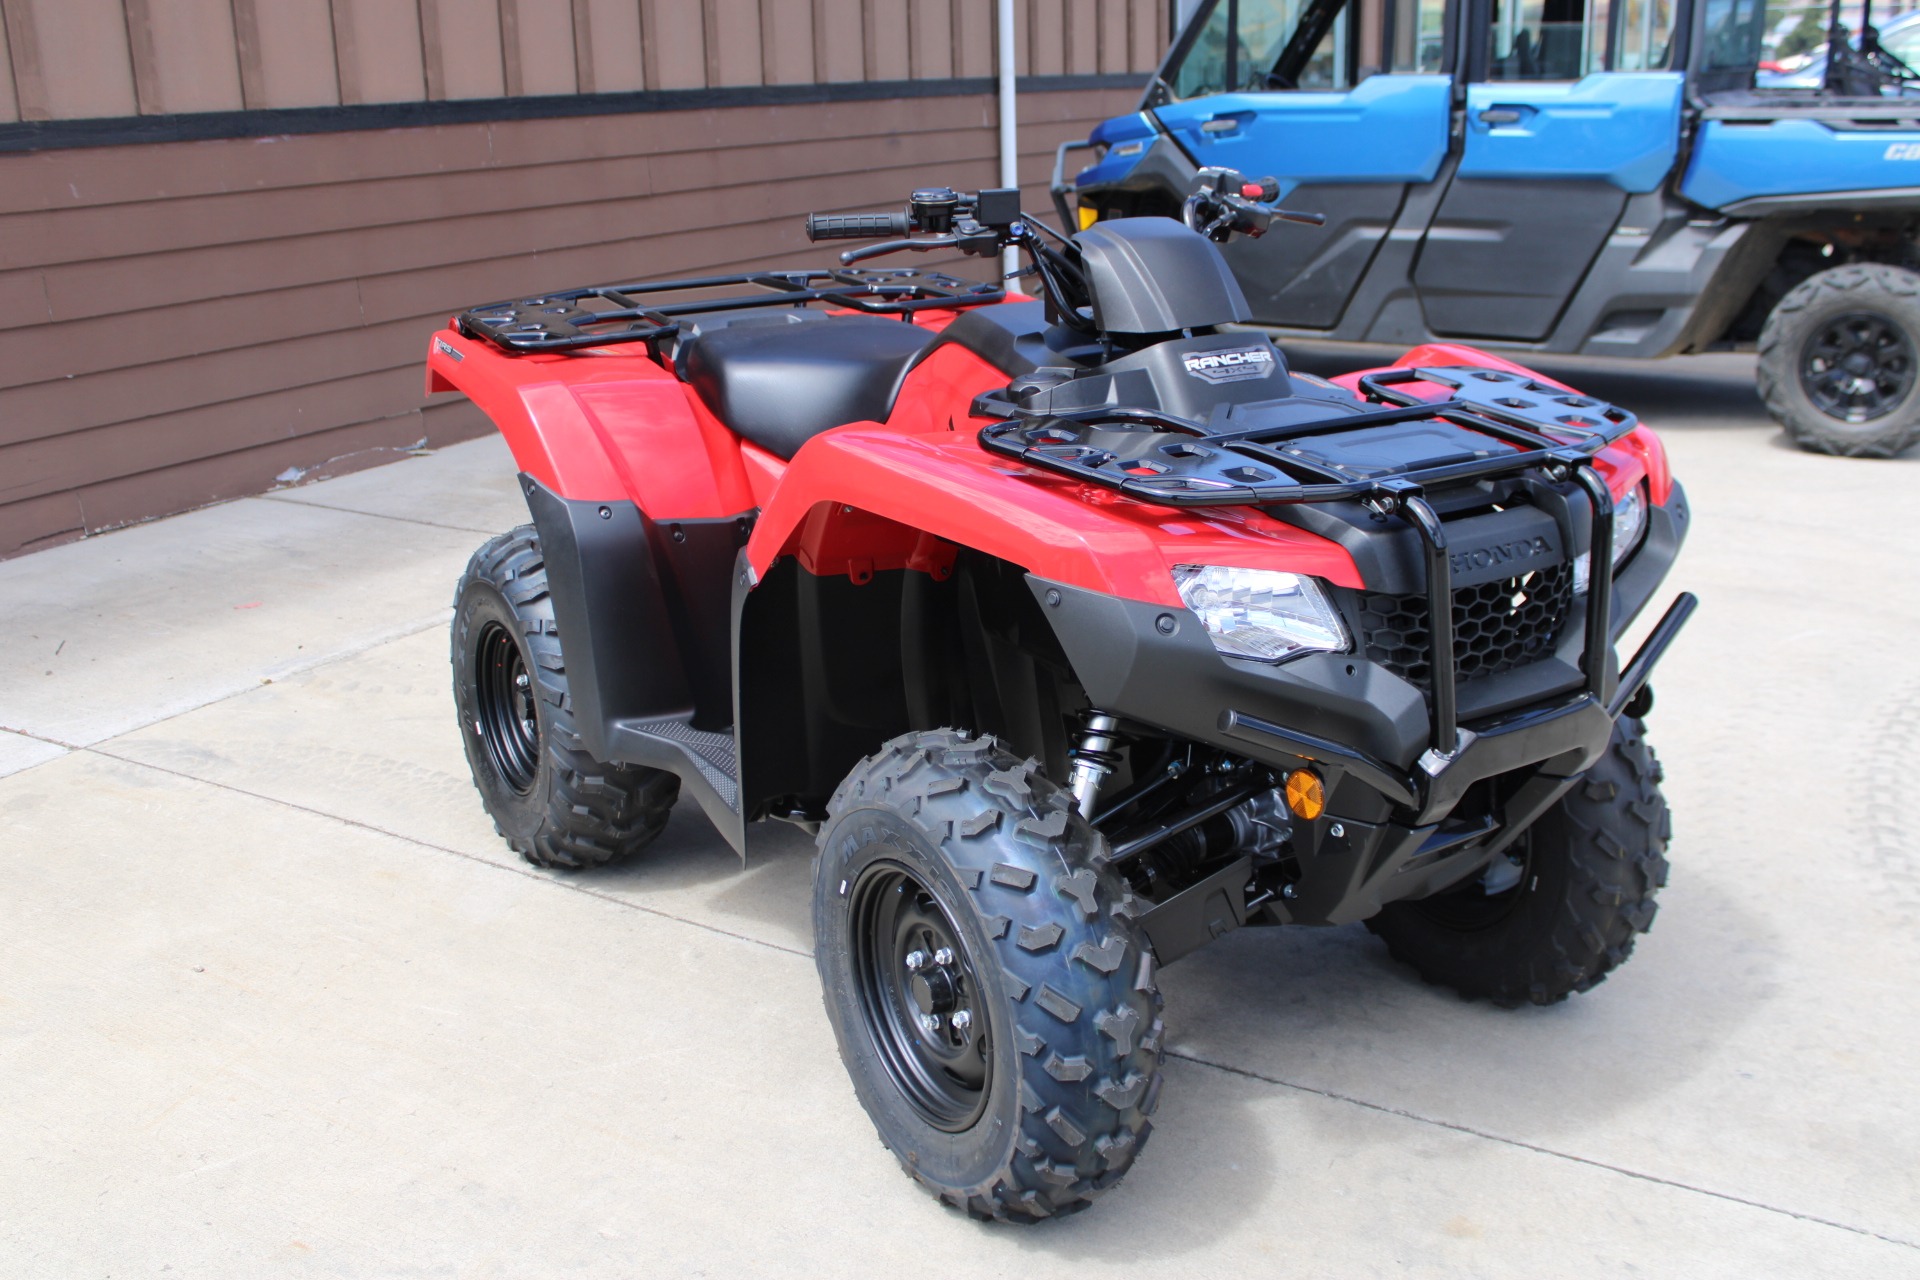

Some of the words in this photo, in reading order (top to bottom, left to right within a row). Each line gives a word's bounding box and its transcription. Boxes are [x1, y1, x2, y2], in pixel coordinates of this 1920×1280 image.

[1184, 351, 1272, 371] RANCHER
[1450, 536, 1553, 573] HONDA
[841, 826, 959, 909] MAXXIS
